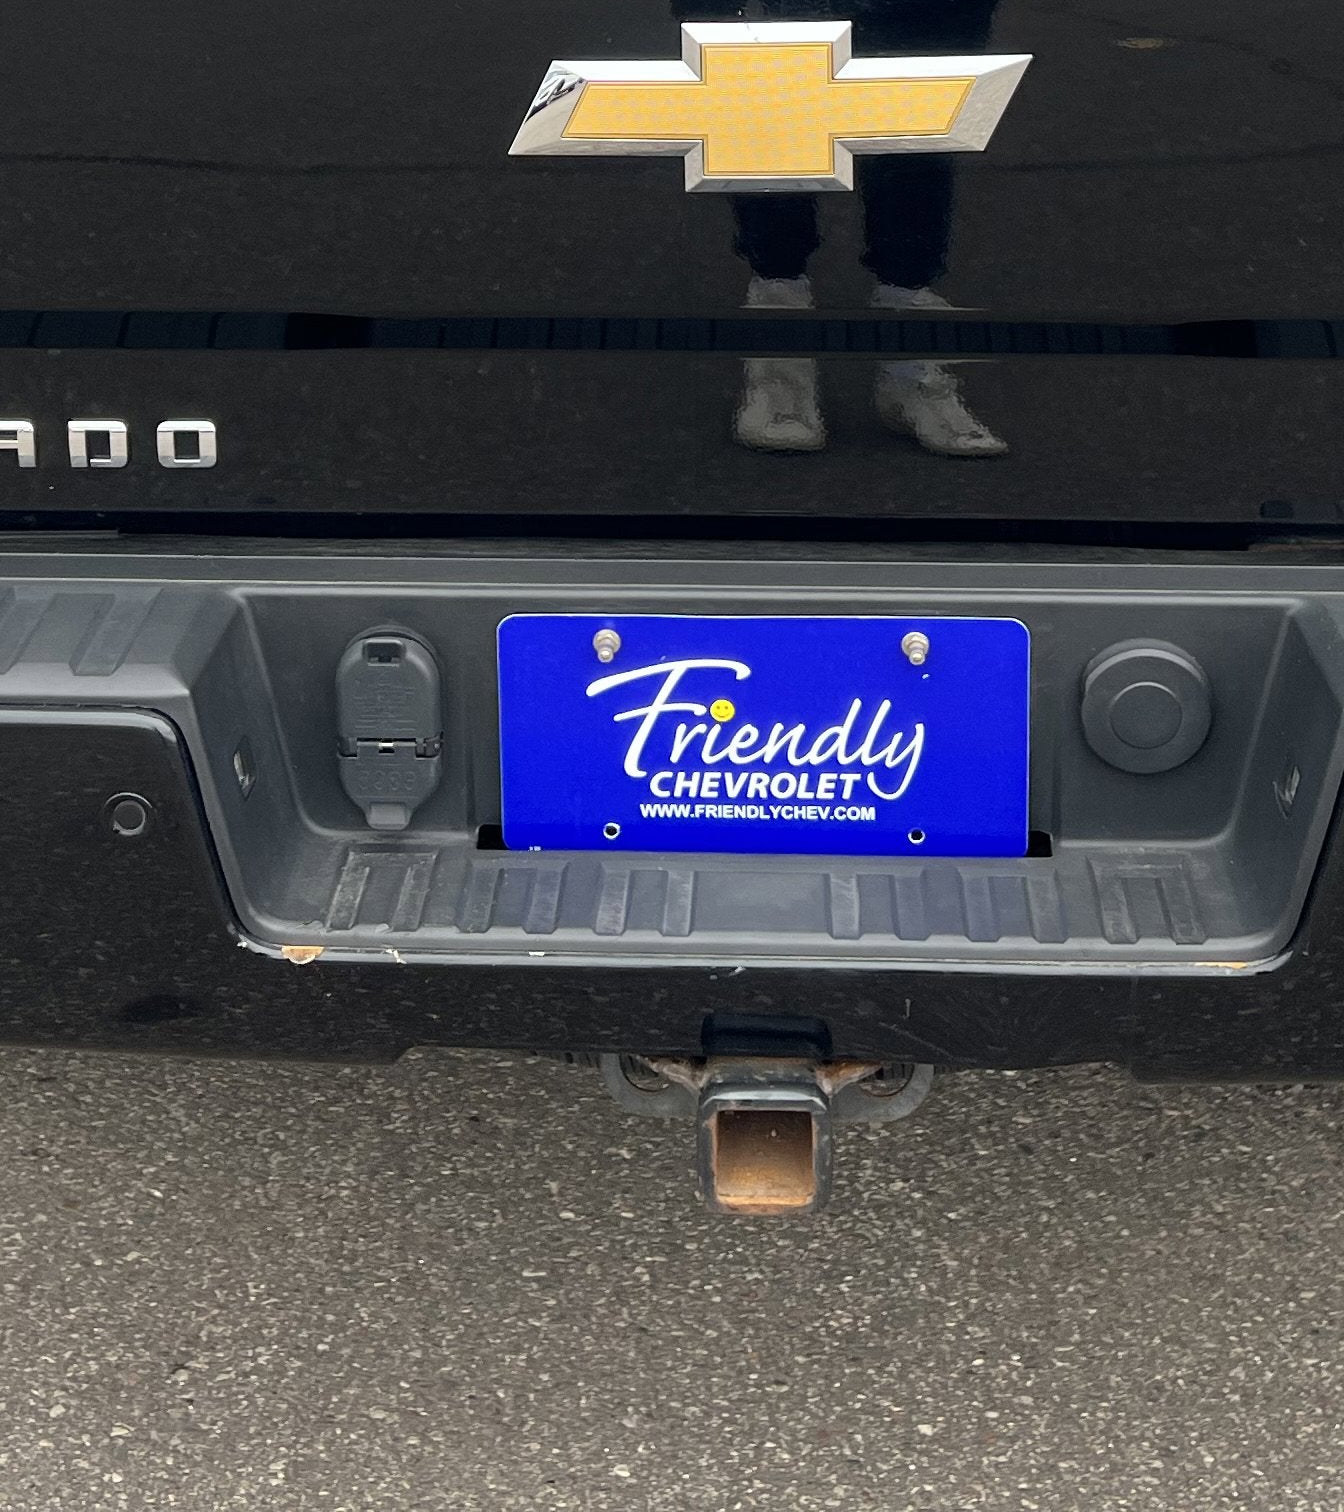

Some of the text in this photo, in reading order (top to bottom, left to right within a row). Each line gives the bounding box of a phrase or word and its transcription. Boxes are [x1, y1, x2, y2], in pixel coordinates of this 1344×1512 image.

[585, 658, 925, 800] Friendly
[649, 771, 862, 800] CHEVROLET
[639, 803, 876, 821] WWW.FRIENDLYCHEV.COM
